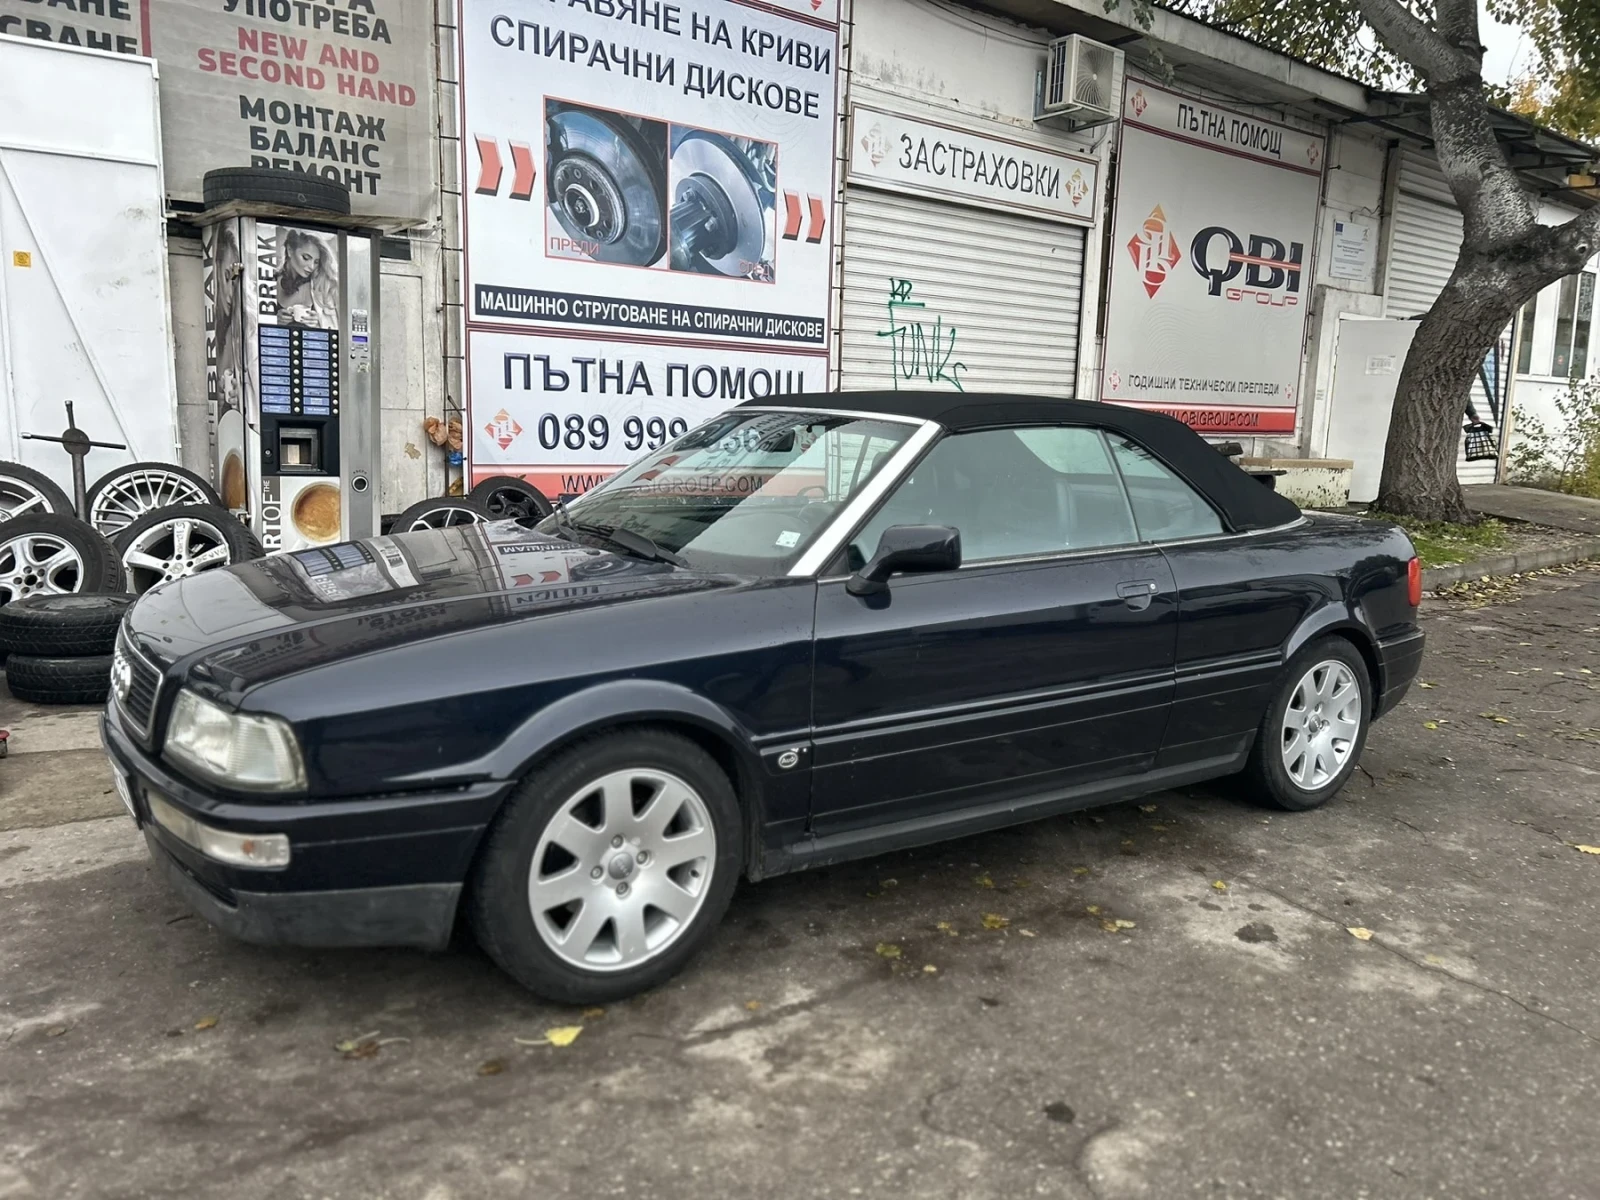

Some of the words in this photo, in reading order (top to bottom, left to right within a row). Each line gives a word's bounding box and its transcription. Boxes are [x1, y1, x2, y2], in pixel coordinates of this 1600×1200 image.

[238, 26, 308, 61] NEW
[319, 43, 379, 74] AND
[490, 14, 674, 86] СПИРАЧНИ
[683, 62, 819, 119] ДИСКОВЕ
[691, 11, 733, 48] НА
[741, 25, 830, 74] КРИВИ
[198, 48, 325, 91] SECOND
[337, 74, 416, 107] HAND
[239, 95, 386, 141] МОНТАЖ
[1177, 104, 1226, 141] ПЪТНА
[1230, 119, 1282, 159] ПОМОЩ
[250, 126, 379, 167] БАЛАНС
[899, 133, 1060, 199] ЗАСТРАХОВКИ
[550, 236, 600, 256] ПРЕДИ
[1190, 226, 1304, 297] QBI
[257, 234, 279, 316] BREAK
[202, 227, 219, 400] BREAK
[479, 290, 568, 317] МАШИННО
[572, 299, 667, 326] СТРУГОВАНЕ
[671, 308, 690, 327] НА
[694, 311, 763, 334] СПИРАЧНИ
[765, 317, 823, 340] ДИСКОВЕ
[503, 352, 654, 396] ПЪТНА
[1128, 374, 1176, 390] ГОДИШНИ
[1179, 377, 1236, 393] ТЕХНИЧЕСКИ
[1237, 381, 1279, 397] ПРЕГЛЕДИ
[537, 412, 609, 451] 089
[623, 415, 688, 451] 999
